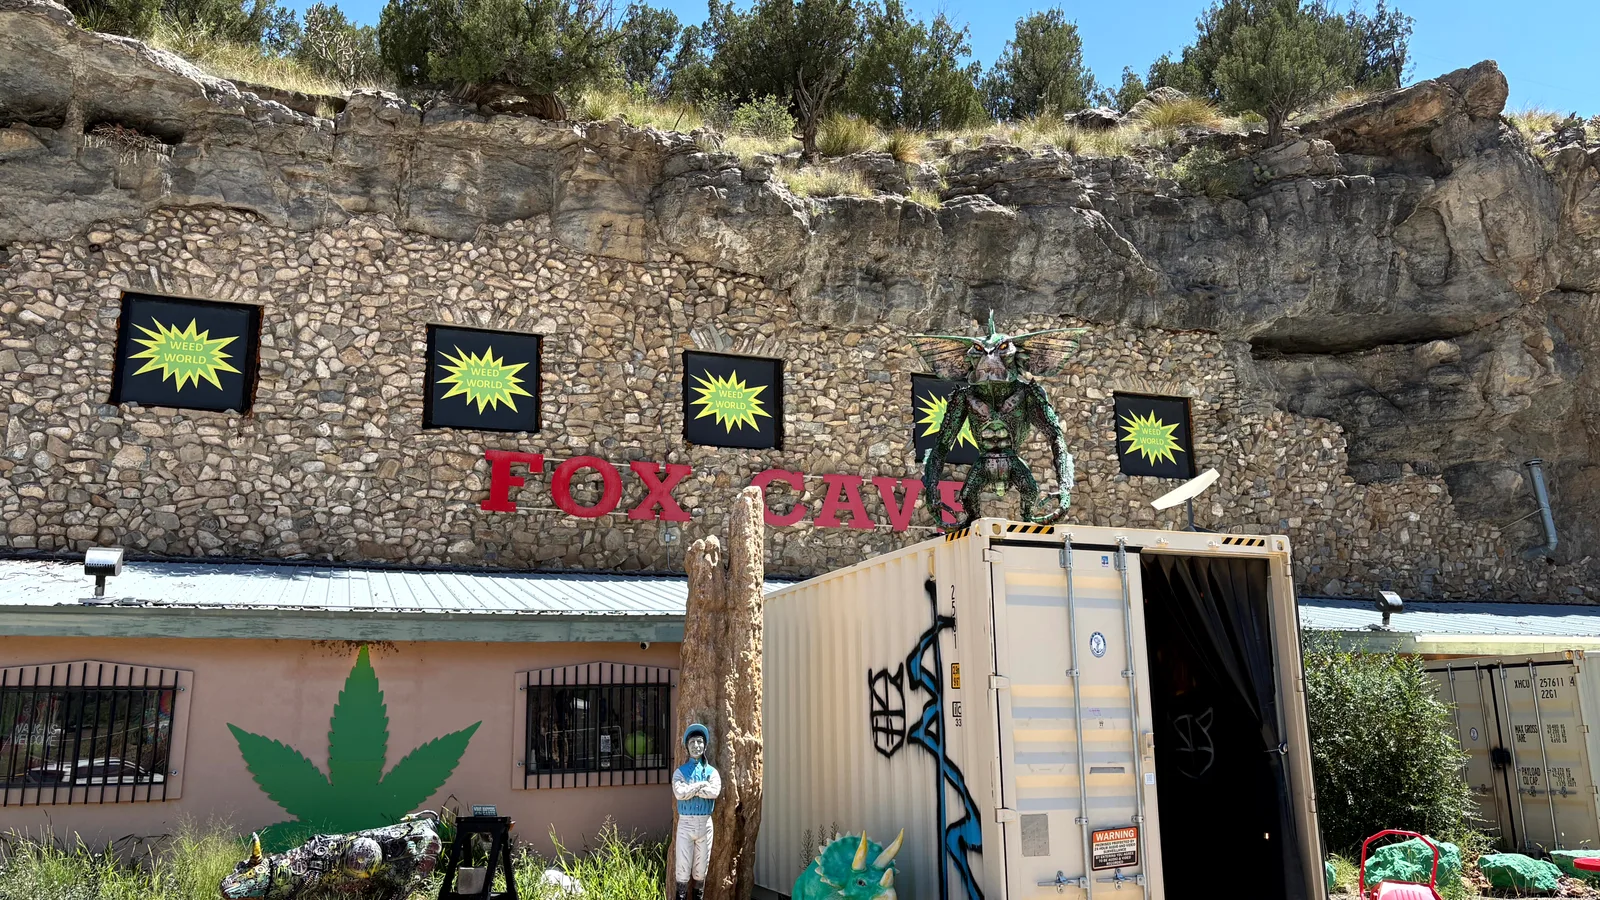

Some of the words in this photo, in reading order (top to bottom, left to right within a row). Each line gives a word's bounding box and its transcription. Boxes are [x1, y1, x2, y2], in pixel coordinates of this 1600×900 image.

[170, 341, 204, 352] WEED
[164, 353, 207, 364] WORLD
[471, 368, 500, 377] WEED
[466, 379, 503, 389] WORLD
[718, 390, 743, 399] WEED
[715, 400, 747, 410] WORLD
[1141, 428, 1161, 436] WEED
[1139, 437, 1164, 446] WORLD
[480, 449, 692, 522] FOX
[1514, 679, 1531, 689] XHCU
[1539, 678, 1564, 687] 257611
[1541, 689, 1558, 699] 22G1
[1514, 725, 1524, 734] MAX
[1524, 724, 1538, 733] GROSS
[1516, 734, 1527, 743] TARE
[1521, 767, 1541, 776] PAYLOAD
[1096, 830, 1134, 841] WARNING
